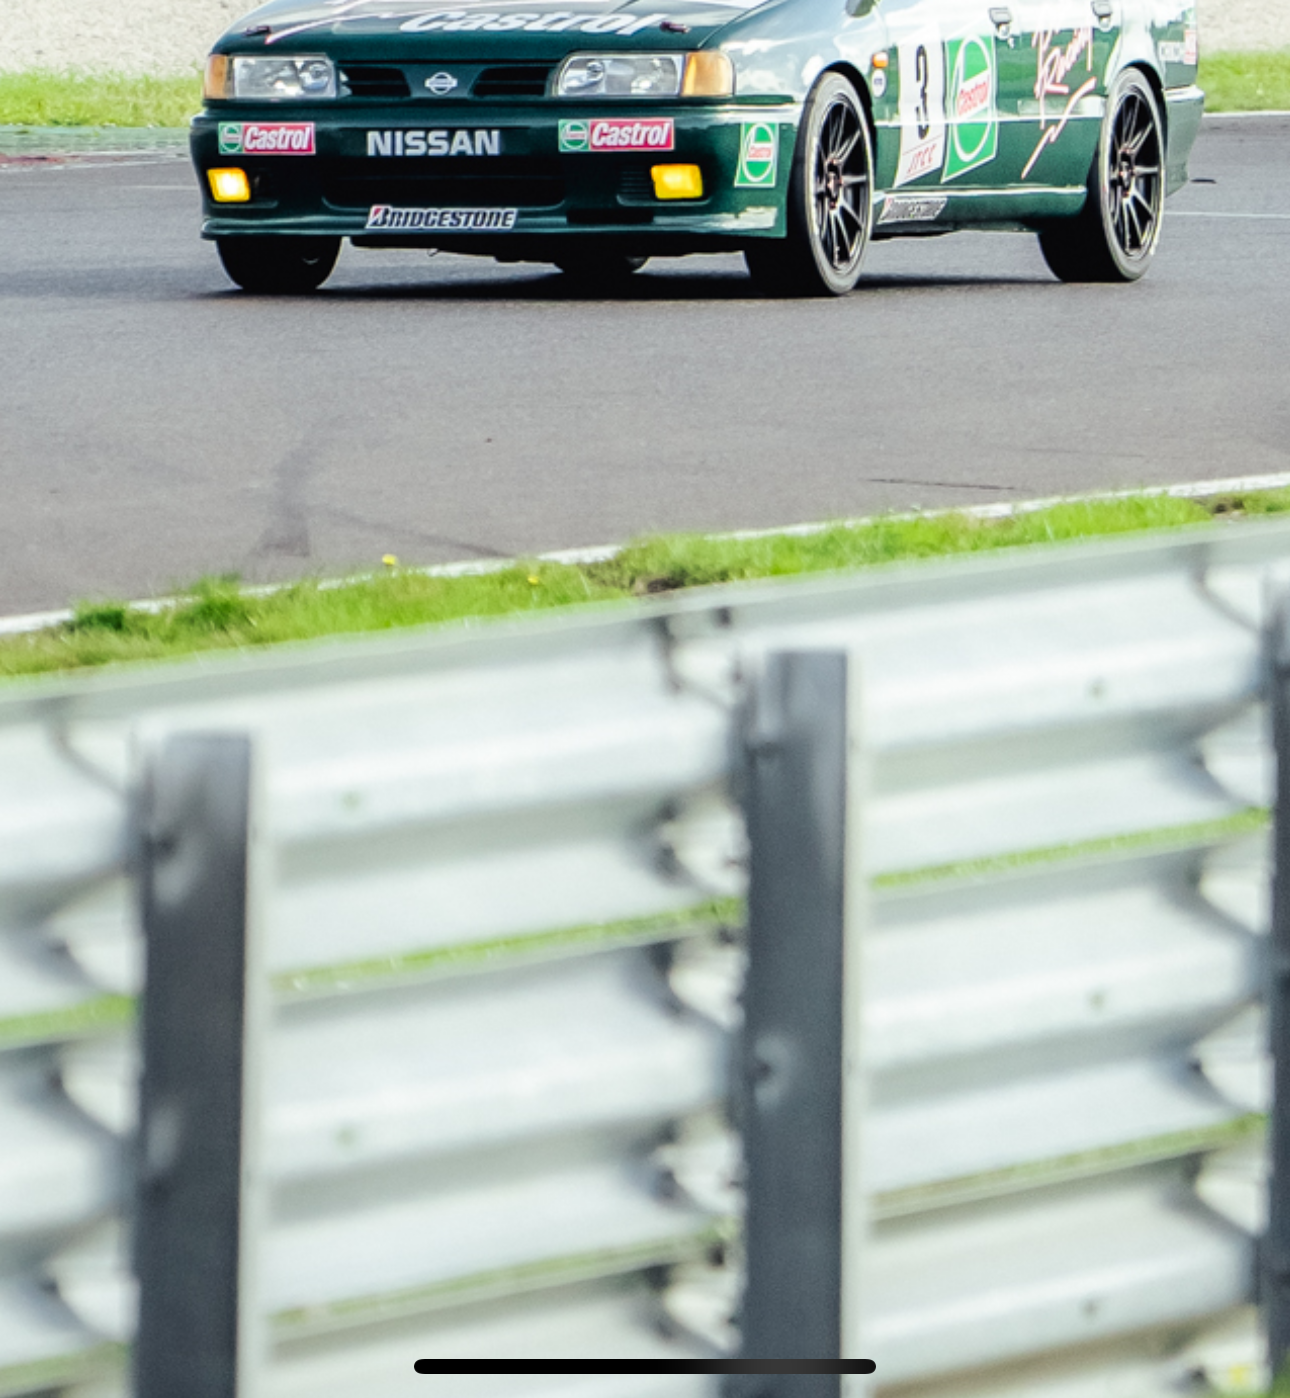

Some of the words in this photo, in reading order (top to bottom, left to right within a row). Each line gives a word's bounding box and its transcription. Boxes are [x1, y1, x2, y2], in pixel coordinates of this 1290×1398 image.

[400, 11, 669, 36] Castrol
[915, 44, 930, 141] 3
[957, 75, 990, 117] Castrol
[244, 125, 312, 151] Castrol
[366, 129, 501, 157] NISSAN
[592, 121, 671, 148] Castrol
[369, 207, 516, 228] BRIDGESTONE
